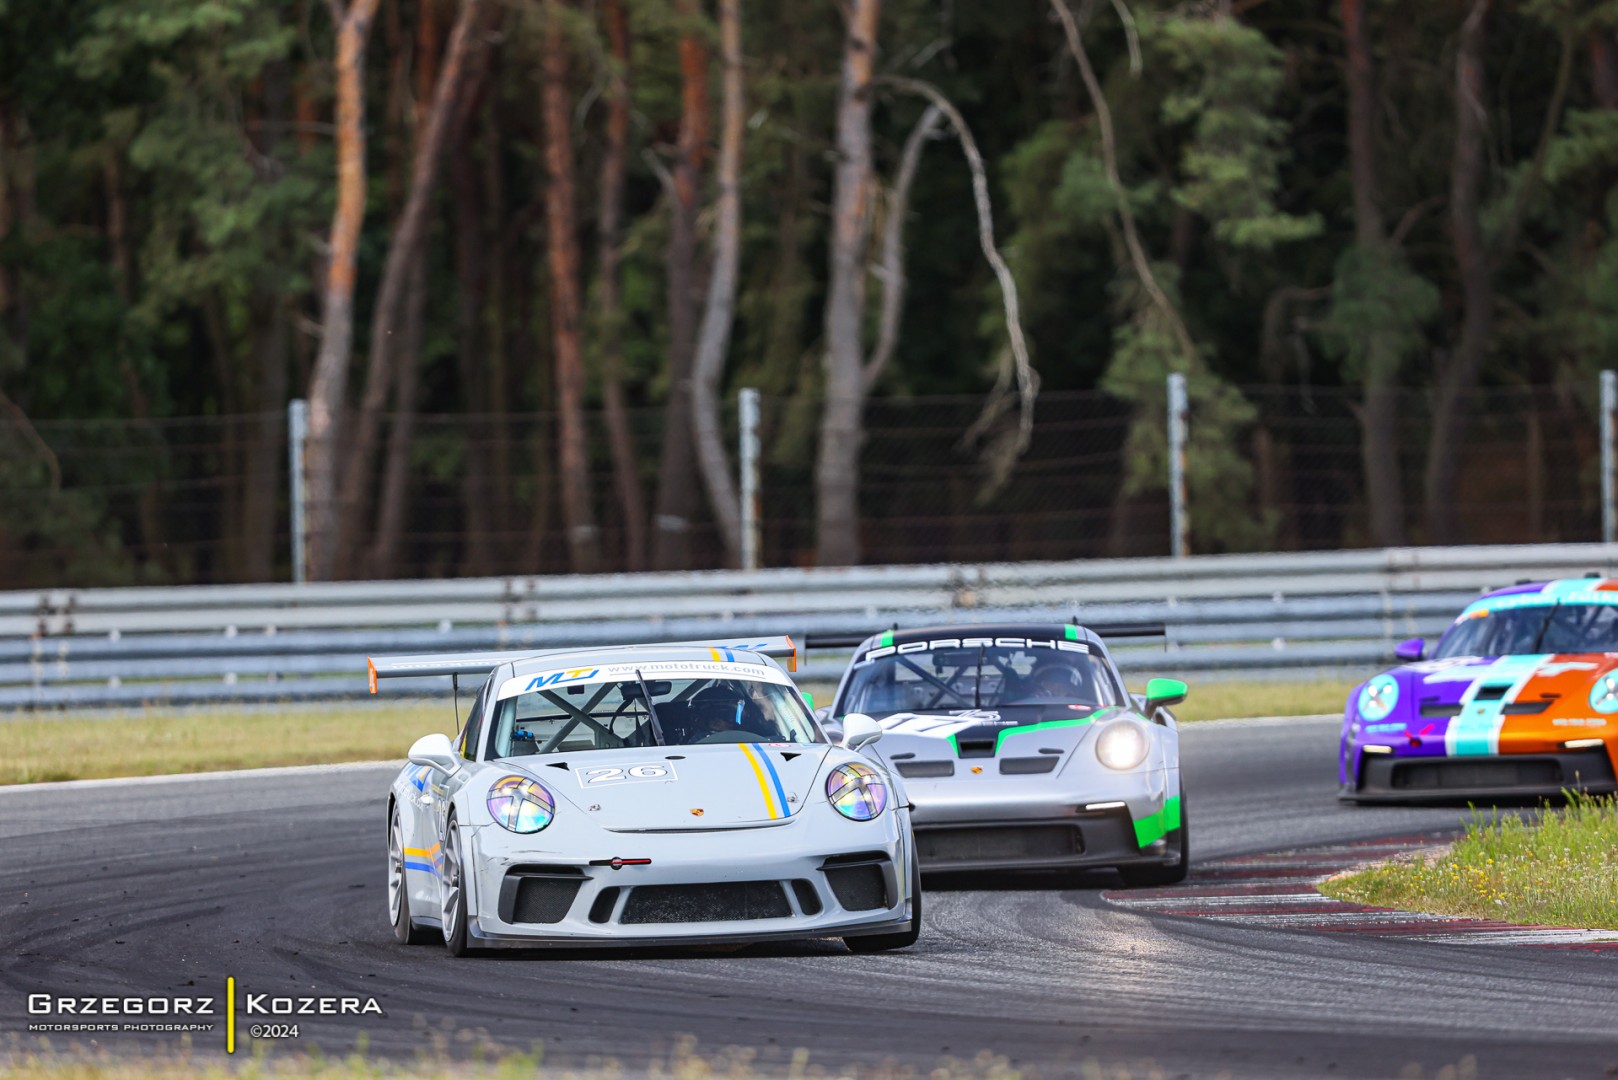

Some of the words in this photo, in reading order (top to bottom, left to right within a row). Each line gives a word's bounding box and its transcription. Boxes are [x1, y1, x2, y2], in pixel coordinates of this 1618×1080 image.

[865, 637, 1090, 662] PORSCHE
[608, 663, 766, 677] www.mototruck.com
[586, 765, 668, 784] 26
